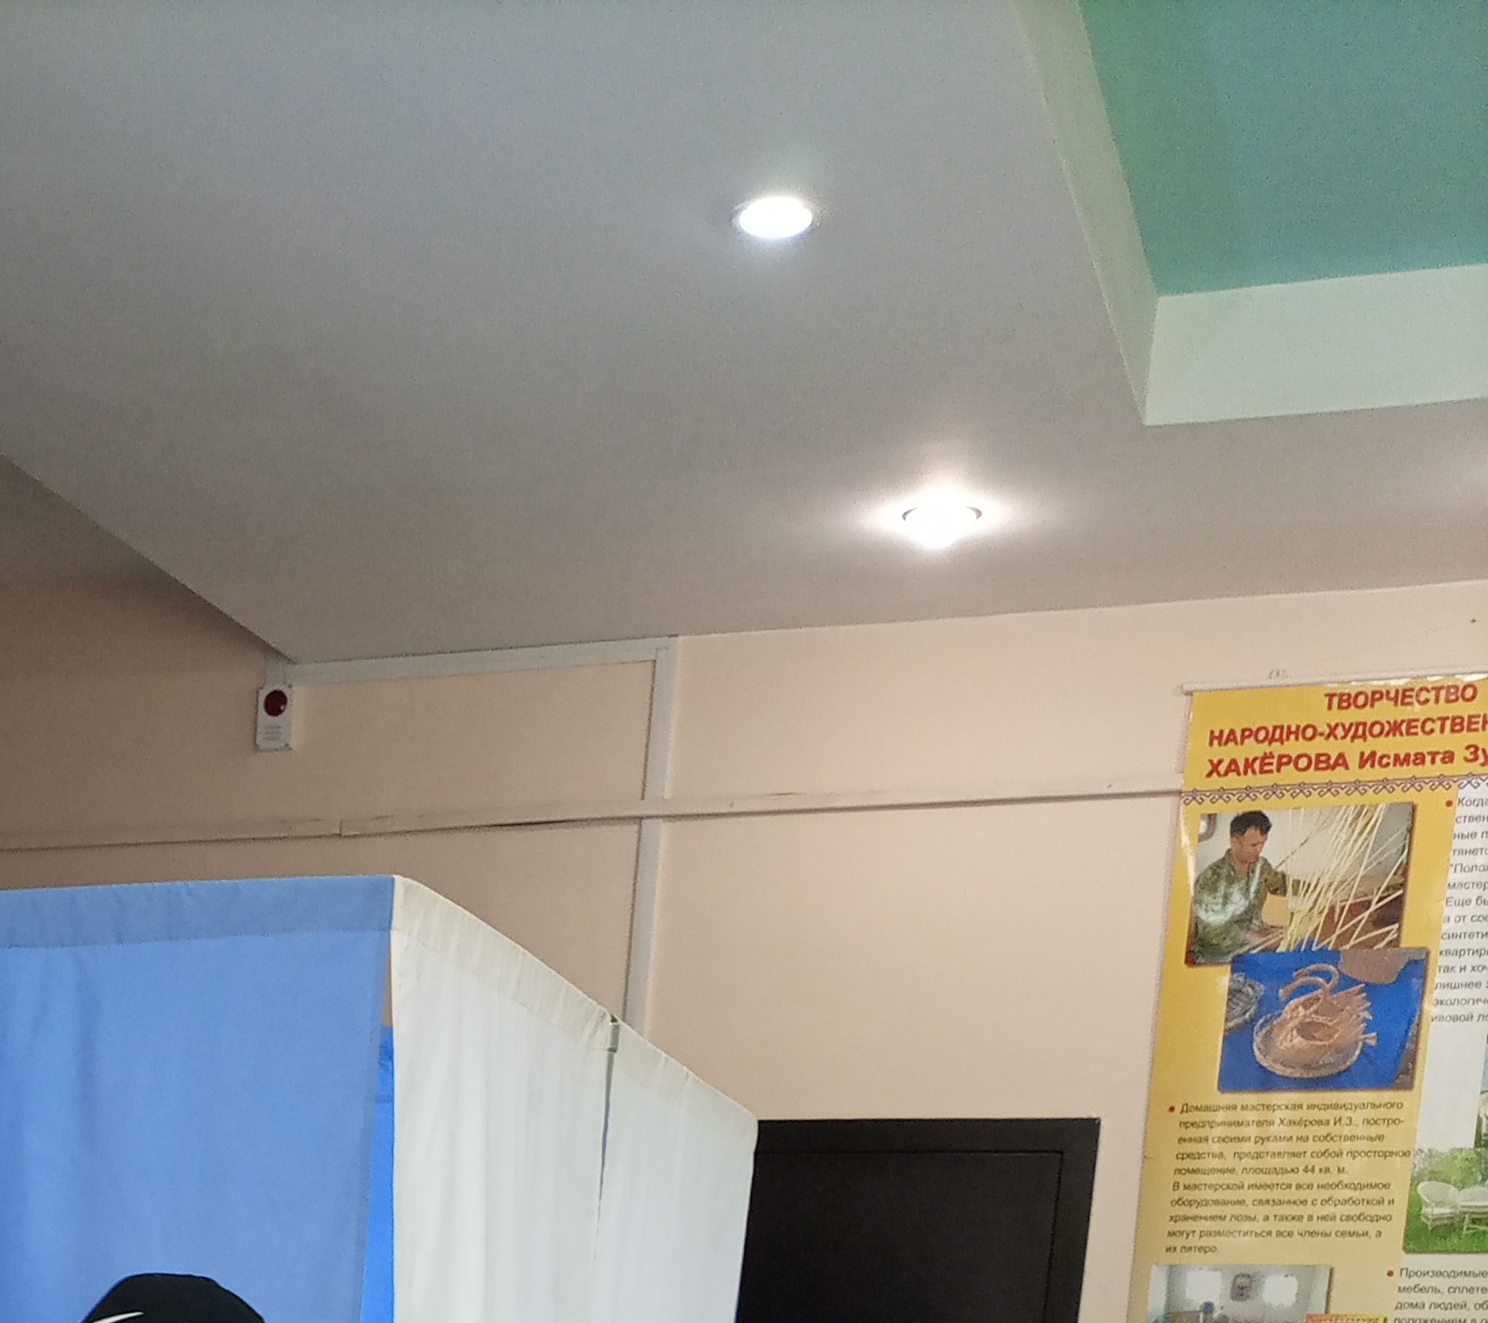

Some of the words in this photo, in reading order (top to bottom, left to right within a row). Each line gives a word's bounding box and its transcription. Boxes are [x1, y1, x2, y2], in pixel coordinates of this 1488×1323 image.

[1324, 683, 1478, 711] ТВОРЧЕСТВО
[1205, 752, 1350, 779] ХАКЁРОВА
[1358, 750, 1455, 770] Исмата
[1180, 1102, 1238, 1115] Домашняя
[1240, 1102, 1304, 1113] мастерская
[1306, 1101, 1404, 1114] индивидуального
[1178, 1119, 1275, 1130] предпринимателя
[1362, 1117, 1405, 1128] постро-
[1211, 1134, 1252, 1144] своими
[1254, 1134, 1293, 1146] руками
[1296, 1135, 1309, 1143] на
[1312, 1132, 1385, 1143] собственные
[1233, 1150, 1308, 1162] представляет
[1310, 1148, 1344, 1159] собой
[1346, 1149, 1411, 1161] просторное
[1241, 1165, 1300, 1177] площадью
[1302, 1164, 1315, 1174] 44
[1172, 1180, 1181, 1192] В
[1183, 1181, 1245, 1194] мастерской
[1247, 1182, 1293, 1192] имеется
[1295, 1182, 1314, 1191] все
[1316, 1179, 1392, 1192] необходимое
[1251, 1198, 1308, 1207] связанное
[1310, 1198, 1318, 1206] с
[1320, 1195, 1385, 1208] обработкой
[1387, 1197, 1395, 1206] и
[1168, 1213, 1227, 1224] хранением
[1262, 1214, 1270, 1222] а
[1273, 1213, 1305, 1223] также
[1307, 1214, 1314, 1222] в
[1316, 1212, 1337, 1222] ней
[1339, 1211, 1393, 1223] свободно
[1167, 1229, 1197, 1240] могут
[1199, 1229, 1273, 1241] разместиться
[1275, 1229, 1294, 1238] все
[1297, 1229, 1333, 1238] члены
[1375, 1229, 1383, 1238] а
[1165, 1244, 1178, 1254] их
[1394, 1300, 1426, 1311] дома
